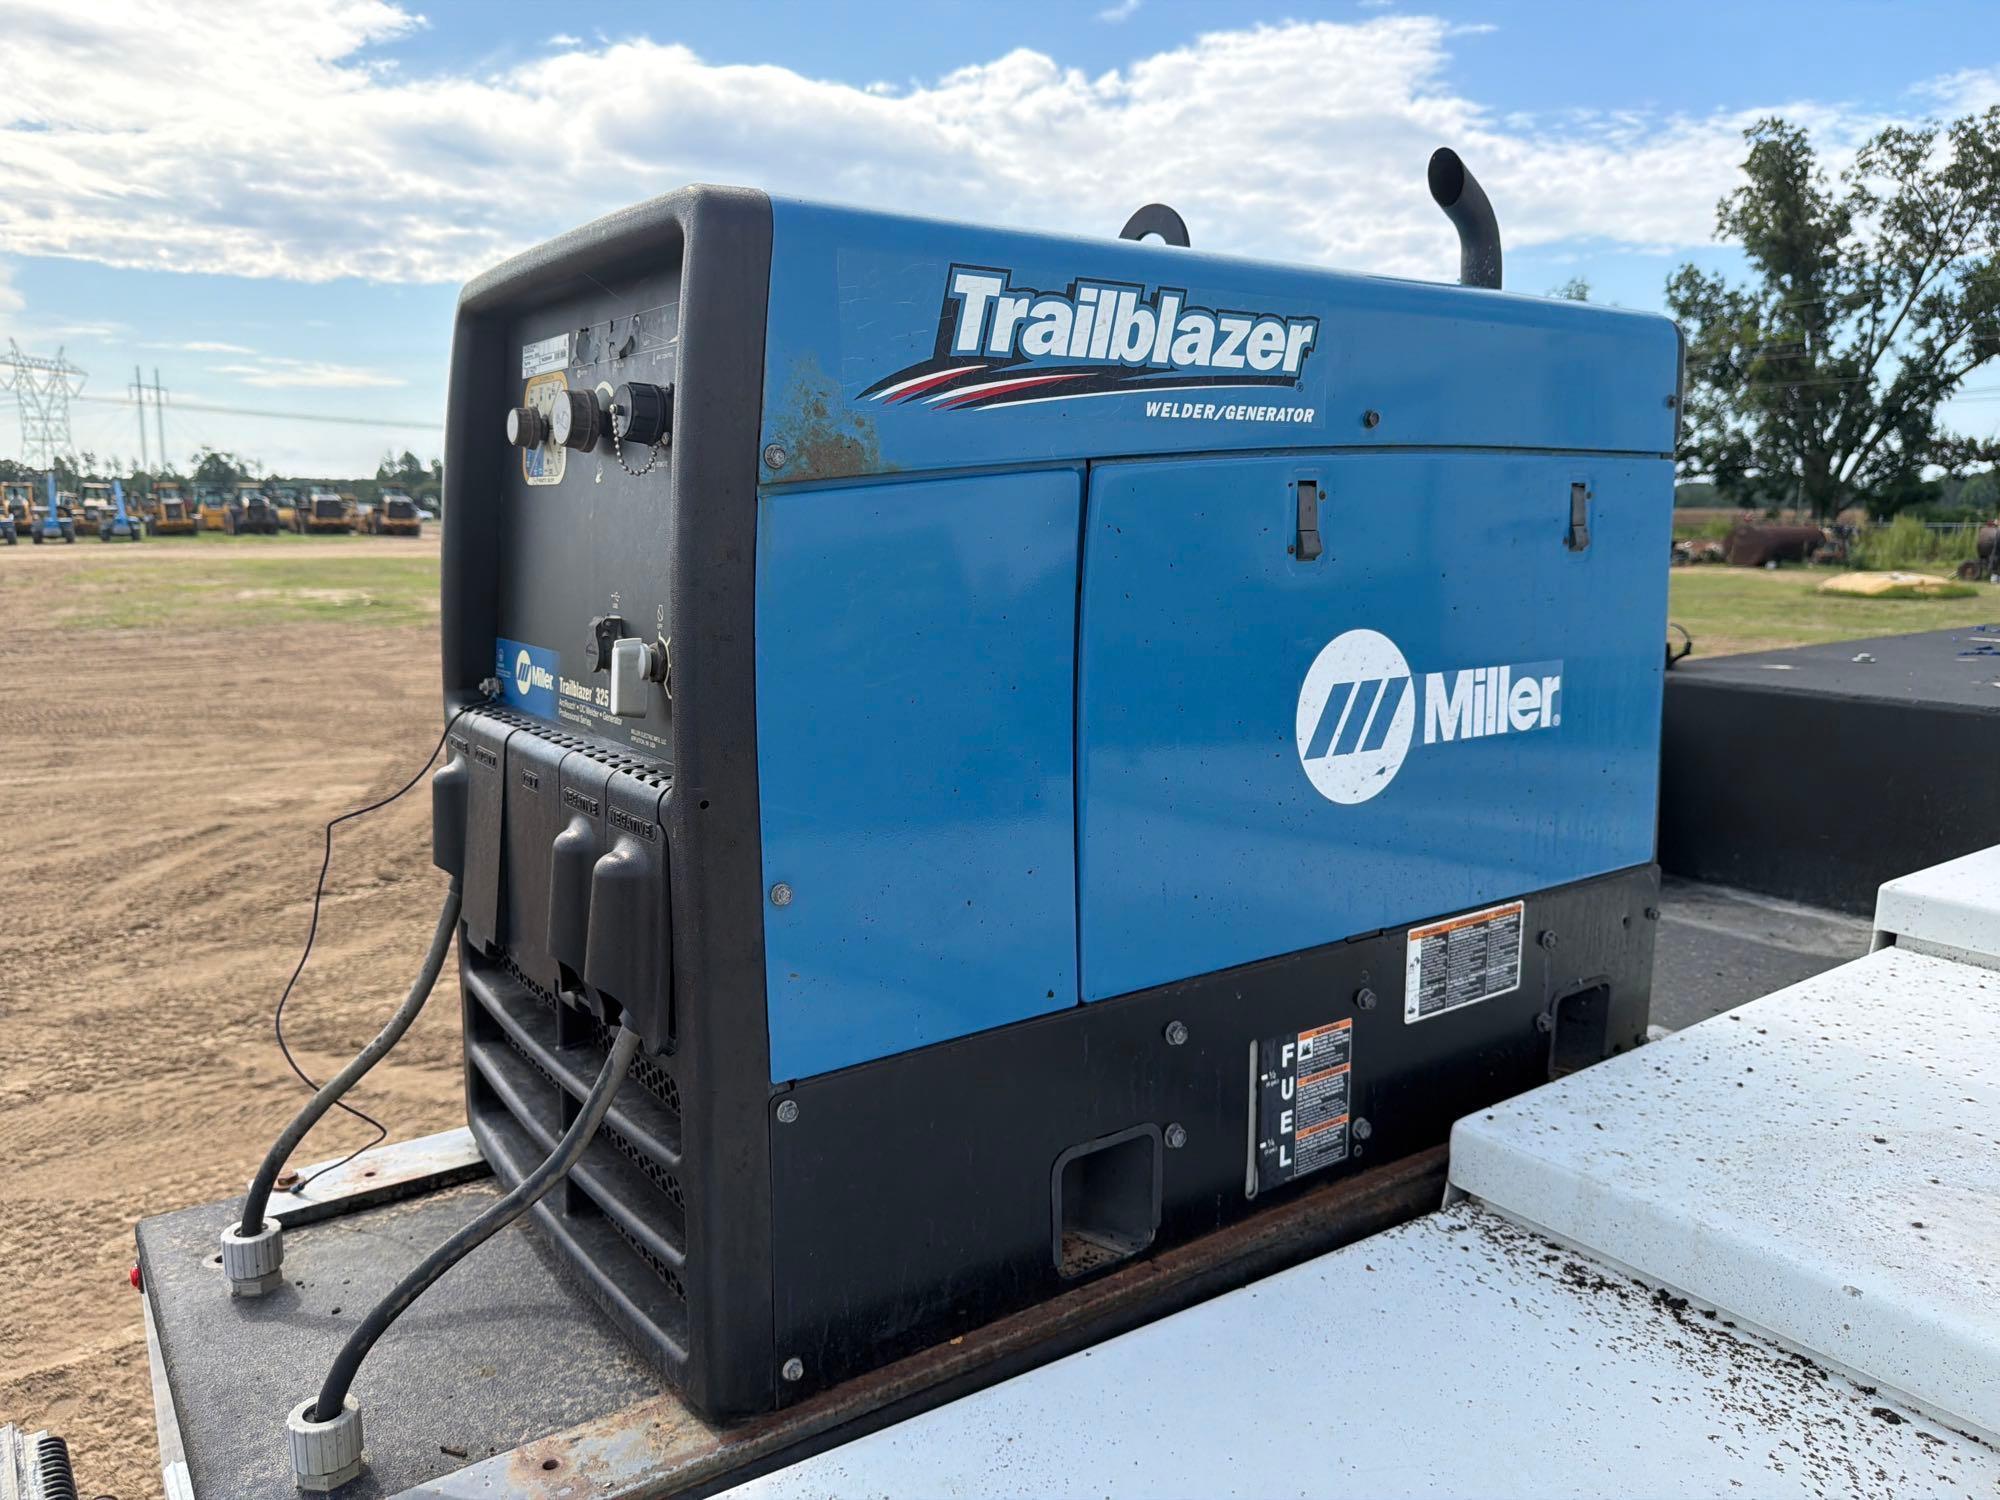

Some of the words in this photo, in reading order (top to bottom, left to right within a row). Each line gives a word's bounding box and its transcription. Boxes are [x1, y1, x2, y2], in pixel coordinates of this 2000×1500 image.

[952, 274, 1312, 373] Trailblazer
[1145, 402, 1315, 423] WELDER/GENERATOR
[532, 665, 553, 690] Miller
[559, 676, 592, 701] Trailblazer
[595, 687, 609, 707] 325
[1424, 665, 1560, 744] Miller
[611, 806, 653, 839] NEGATIVE
[1279, 1043, 1295, 1167] FUEL
